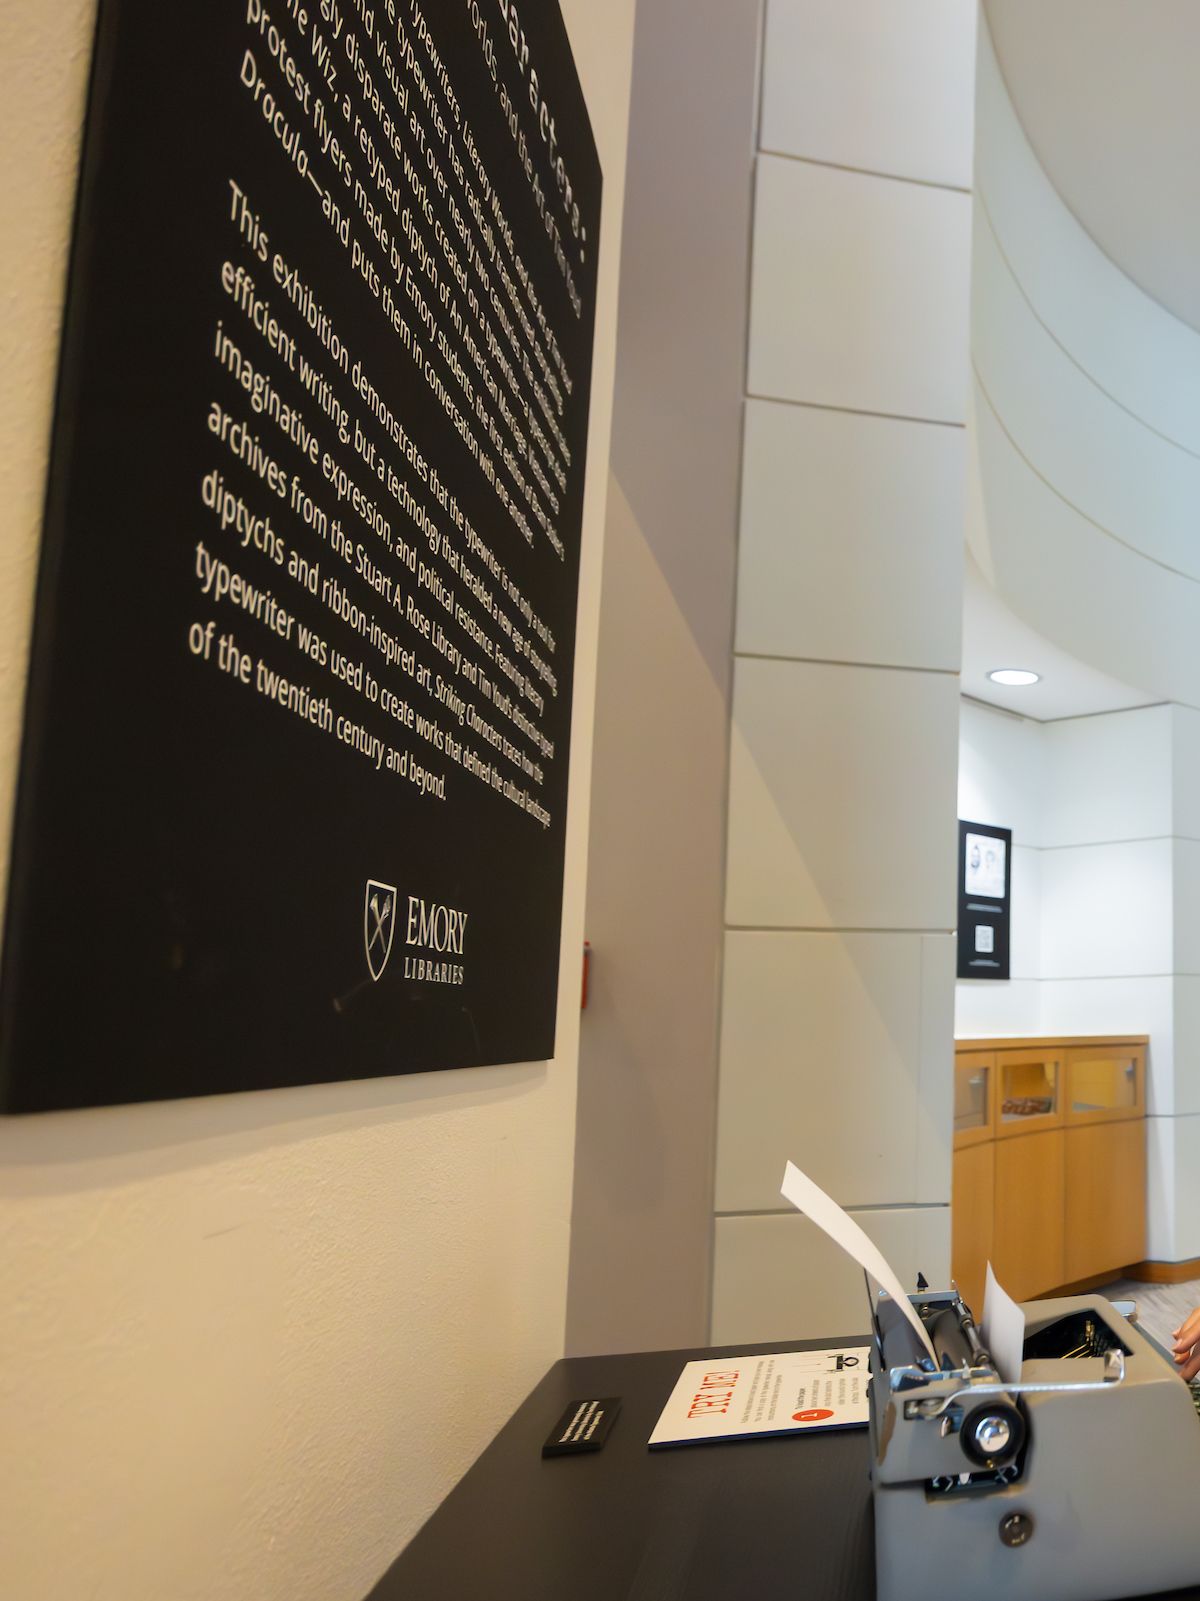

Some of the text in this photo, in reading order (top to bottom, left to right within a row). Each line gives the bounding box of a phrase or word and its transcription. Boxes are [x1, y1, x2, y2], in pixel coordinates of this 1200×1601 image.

[310, 23, 339, 103] Wiz,
[341, 93, 352, 123] a
[353, 113, 401, 216] retyped
[400, 206, 438, 289] diptych
[438, 281, 452, 310] of
[448, 298, 463, 336] An
[461, 323, 498, 403] American
[344, 32, 402, 161] disparate
[402, 150, 434, 226] works
[433, 219, 468, 295] created
[466, 287, 479, 319] on
[478, 310, 486, 331] a
[375, 30, 409, 116] visual
[408, 109, 426, 155] art
[425, 146, 449, 199] over
[447, 193, 476, 263] nearly
[474, 249, 490, 292] two
[396, 15, 448, 145] typewriter
[447, 133, 465, 186] has
[463, 178, 497, 263] radically
[461, 119, 492, 202] Literary
[490, 188, 515, 262] Worlds,
[514, 254, 529, 289] and
[466, 0, 499, 93] orlds,
[498, 81, 519, 141] and
[517, 129, 533, 183] the
[530, 172, 546, 219] Art
[245, 0, 311, 115] protest
[312, 97, 353, 187] flyers
[353, 178, 389, 254] made
[389, 235, 405, 285] by
[404, 265, 438, 343] Emory
[436, 329, 475, 410] students,
[474, 394, 489, 431] the
[487, 415, 504, 457] first
[523, 483, 534, 505] of
[350, 237, 381, 298] puts
[381, 284, 411, 350] them
[411, 332, 423, 369] in
[423, 359, 479, 460] conversation
[478, 447, 496, 486] with
[494, 476, 509, 508] one
[213, 319, 319, 465] imaginative
[321, 452, 394, 553] expression,
[394, 535, 417, 574] and
[416, 560, 455, 615] political
[493, 642, 526, 698] Featuring
[220, 260, 297, 372] efficient
[298, 354, 351, 444] writing,
[353, 418, 377, 471] but
[376, 457, 385, 482] a
[386, 464, 442, 555] technology
[440, 534, 460, 574] that
[458, 553, 493, 614] heralded
[491, 602, 498, 621] a
[497, 608, 513, 638] new
[510, 626, 524, 653] age
[522, 638, 532, 659] of
[228, 178, 269, 262] This
[271, 253, 349, 374] exhibition
[350, 359, 429, 483] demonstrates
[428, 467, 449, 512] that
[448, 495, 464, 532] the
[463, 516, 502, 581] typewriter
[500, 565, 509, 591] is
[507, 580, 521, 608] not
[531, 613, 538, 630] a
[195, 540, 296, 641] typewriter
[297, 622, 328, 666] was
[329, 648, 364, 692] used
[364, 670, 379, 703] to
[379, 687, 415, 729] create
[414, 712, 444, 751] works
[443, 730, 463, 764] that
[461, 744, 492, 784] defined
[490, 766, 504, 793] the
[200, 468, 285, 566] diptychs
[286, 549, 320, 596] and
[320, 576, 416, 678] ribbon-inspired
[415, 662, 433, 697] art,
[433, 673, 467, 726] Striking
[501, 735, 522, 768] traces
[206, 401, 288, 499] archives
[290, 474, 328, 539] from
[329, 518, 353, 564] the
[354, 542, 393, 603] Stuart
[391, 582, 404, 616] A.
[405, 594, 431, 640] Rose
[430, 619, 462, 675] Library
[460, 656, 478, 685] and
[476, 666, 492, 700] Tim
[188, 620, 447, 801] of the twentieth century and beyond.
[403, 956, 465, 985] LIBRARIES
[405, 896, 469, 955] EMORY
[687, 1369, 740, 1419] TRY ME!
